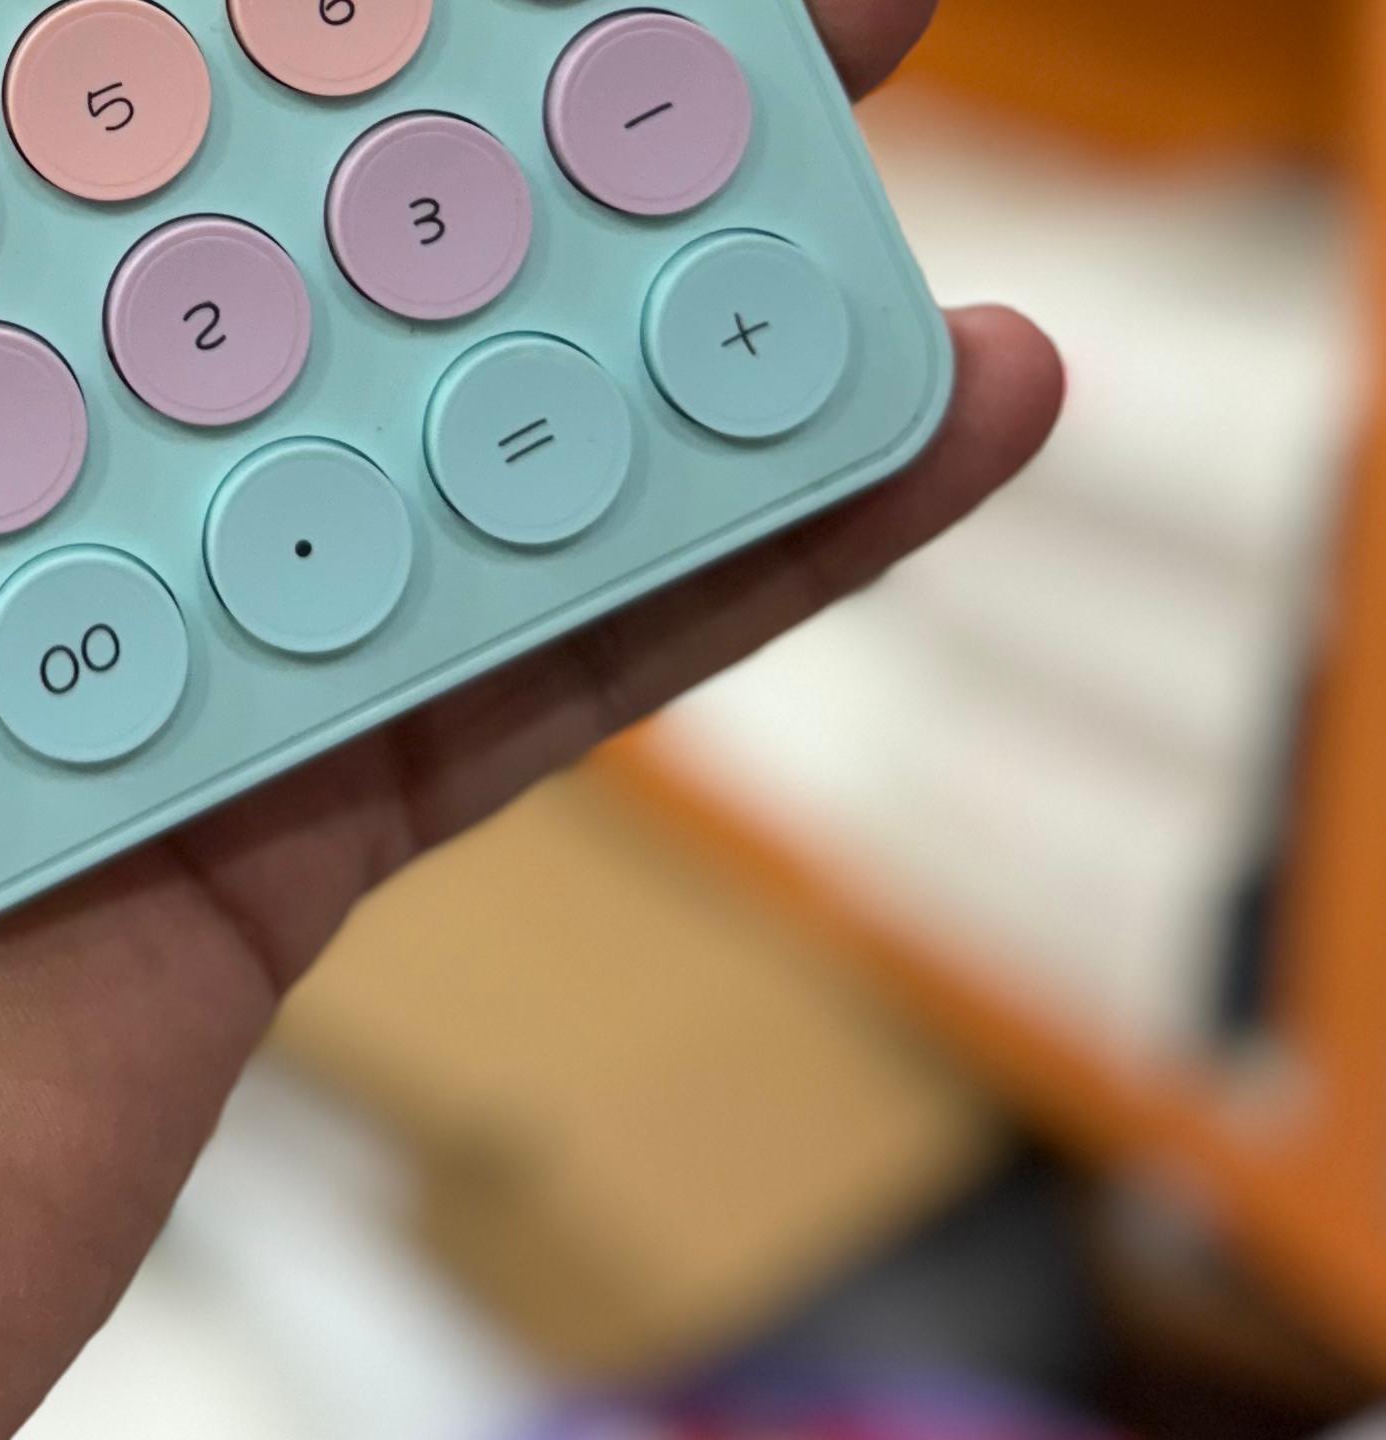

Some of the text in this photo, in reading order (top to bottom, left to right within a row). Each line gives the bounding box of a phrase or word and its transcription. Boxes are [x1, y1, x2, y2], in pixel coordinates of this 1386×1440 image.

[87, 81, 135, 132] 5
[409, 197, 446, 246] 3
[182, 300, 227, 351] 2
[39, 623, 121, 695] 00
